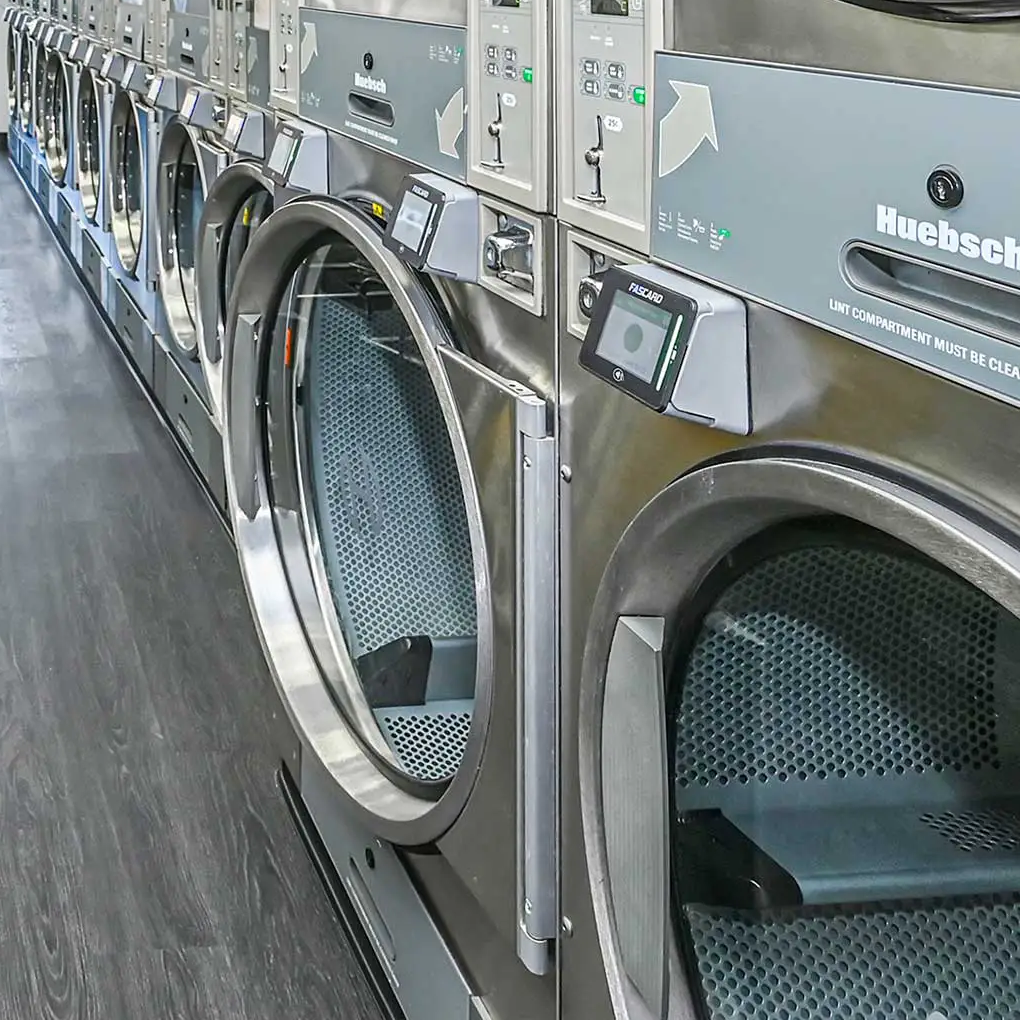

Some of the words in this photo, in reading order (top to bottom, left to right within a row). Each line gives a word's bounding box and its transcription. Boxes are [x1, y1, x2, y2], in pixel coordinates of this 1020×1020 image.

[876, 204, 1020, 272] Huebsch
[628, 282, 664, 304] FASCARD
[829, 298, 851, 316] LINT
[851, 306, 933, 346] COMPARTMENT
[934, 336, 968, 360] MUST
[969, 349, 988, 369] BE
